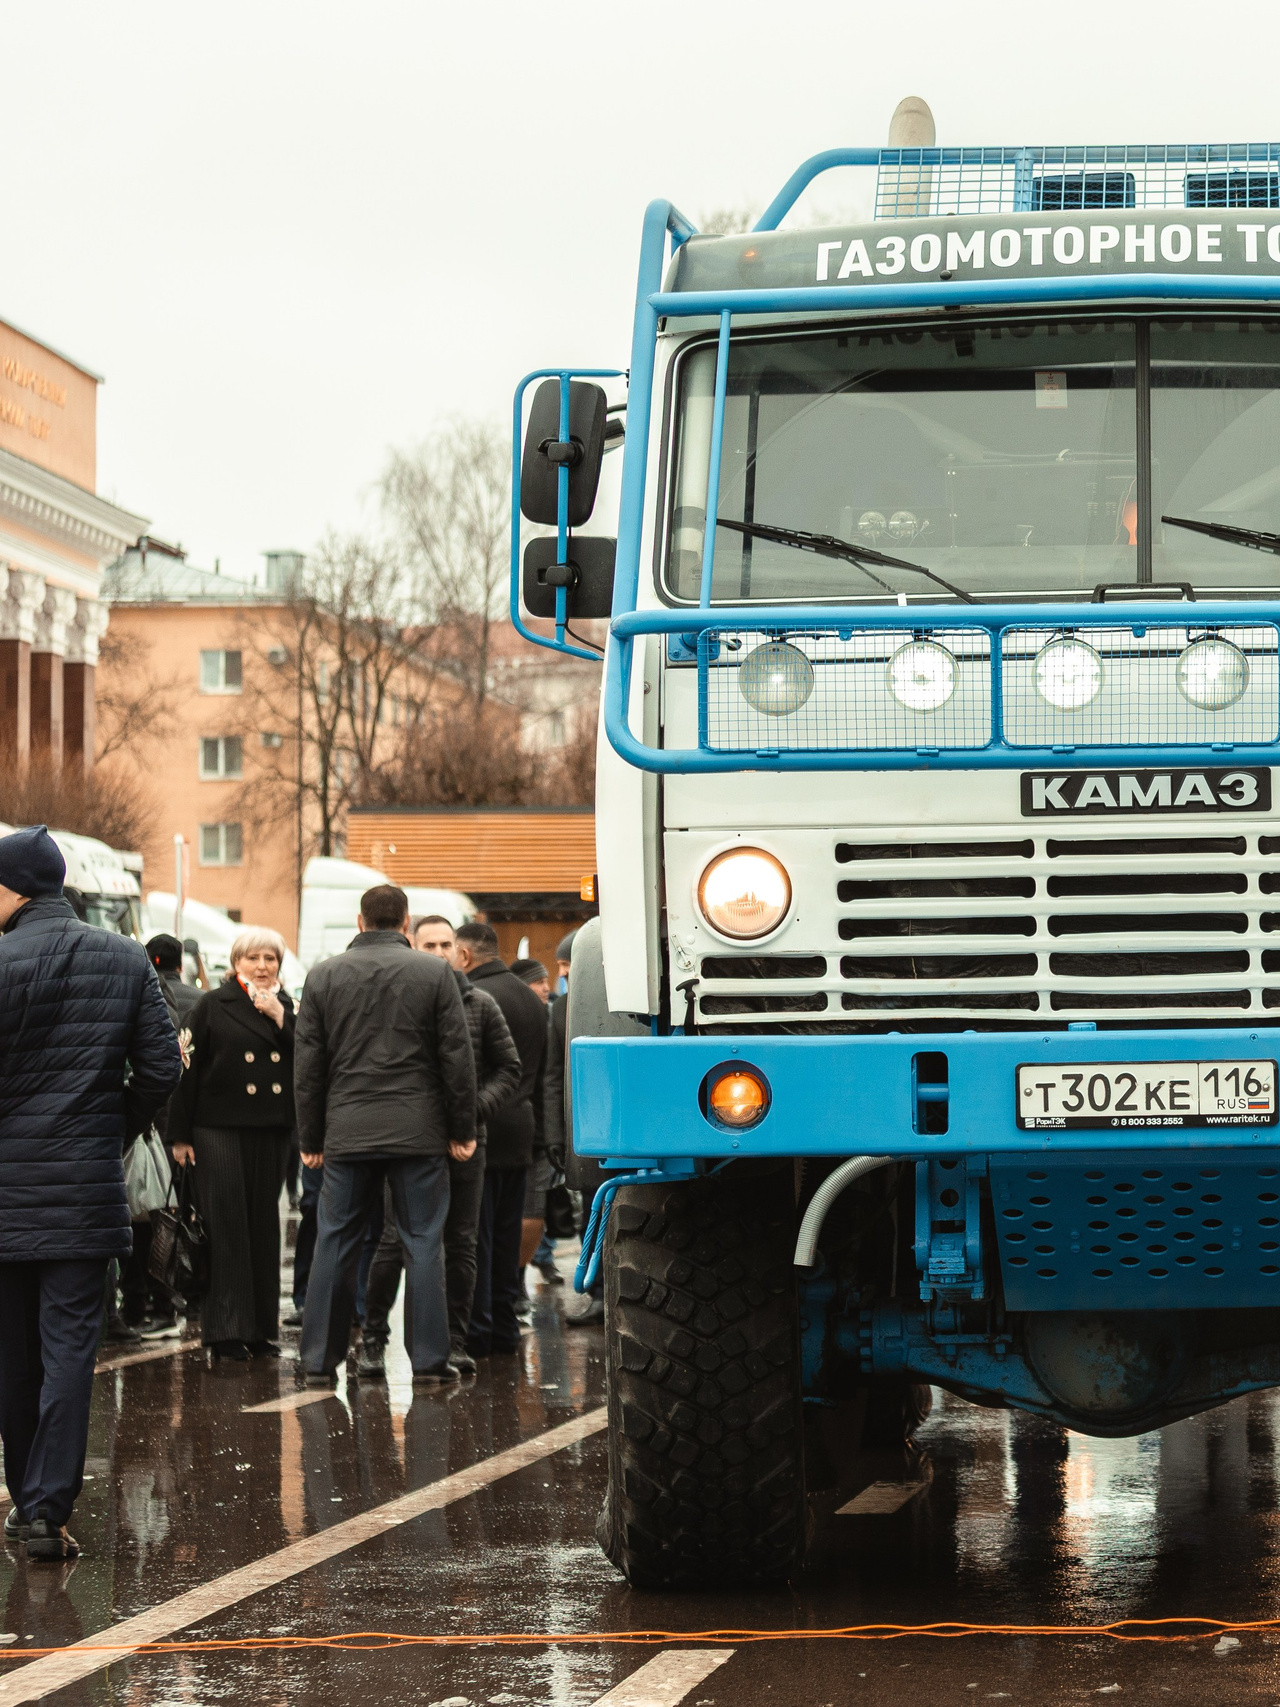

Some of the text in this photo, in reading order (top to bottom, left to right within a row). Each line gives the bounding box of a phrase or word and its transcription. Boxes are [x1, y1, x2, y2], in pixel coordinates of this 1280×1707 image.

[815, 224, 1223, 281] ГАЗОМОТОРНОЕ
[1030, 772, 1260, 810] КАМАЗ
[1204, 1068, 1262, 1097] 116
[1217, 1098, 1247, 1110] RUS
[1120, 1118, 1127, 1126] 8
[1146, 1117, 1162, 1125] 333
[1162, 1117, 1184, 1125] 2552
[1206, 1115, 1271, 1124] www.raritek.ru
